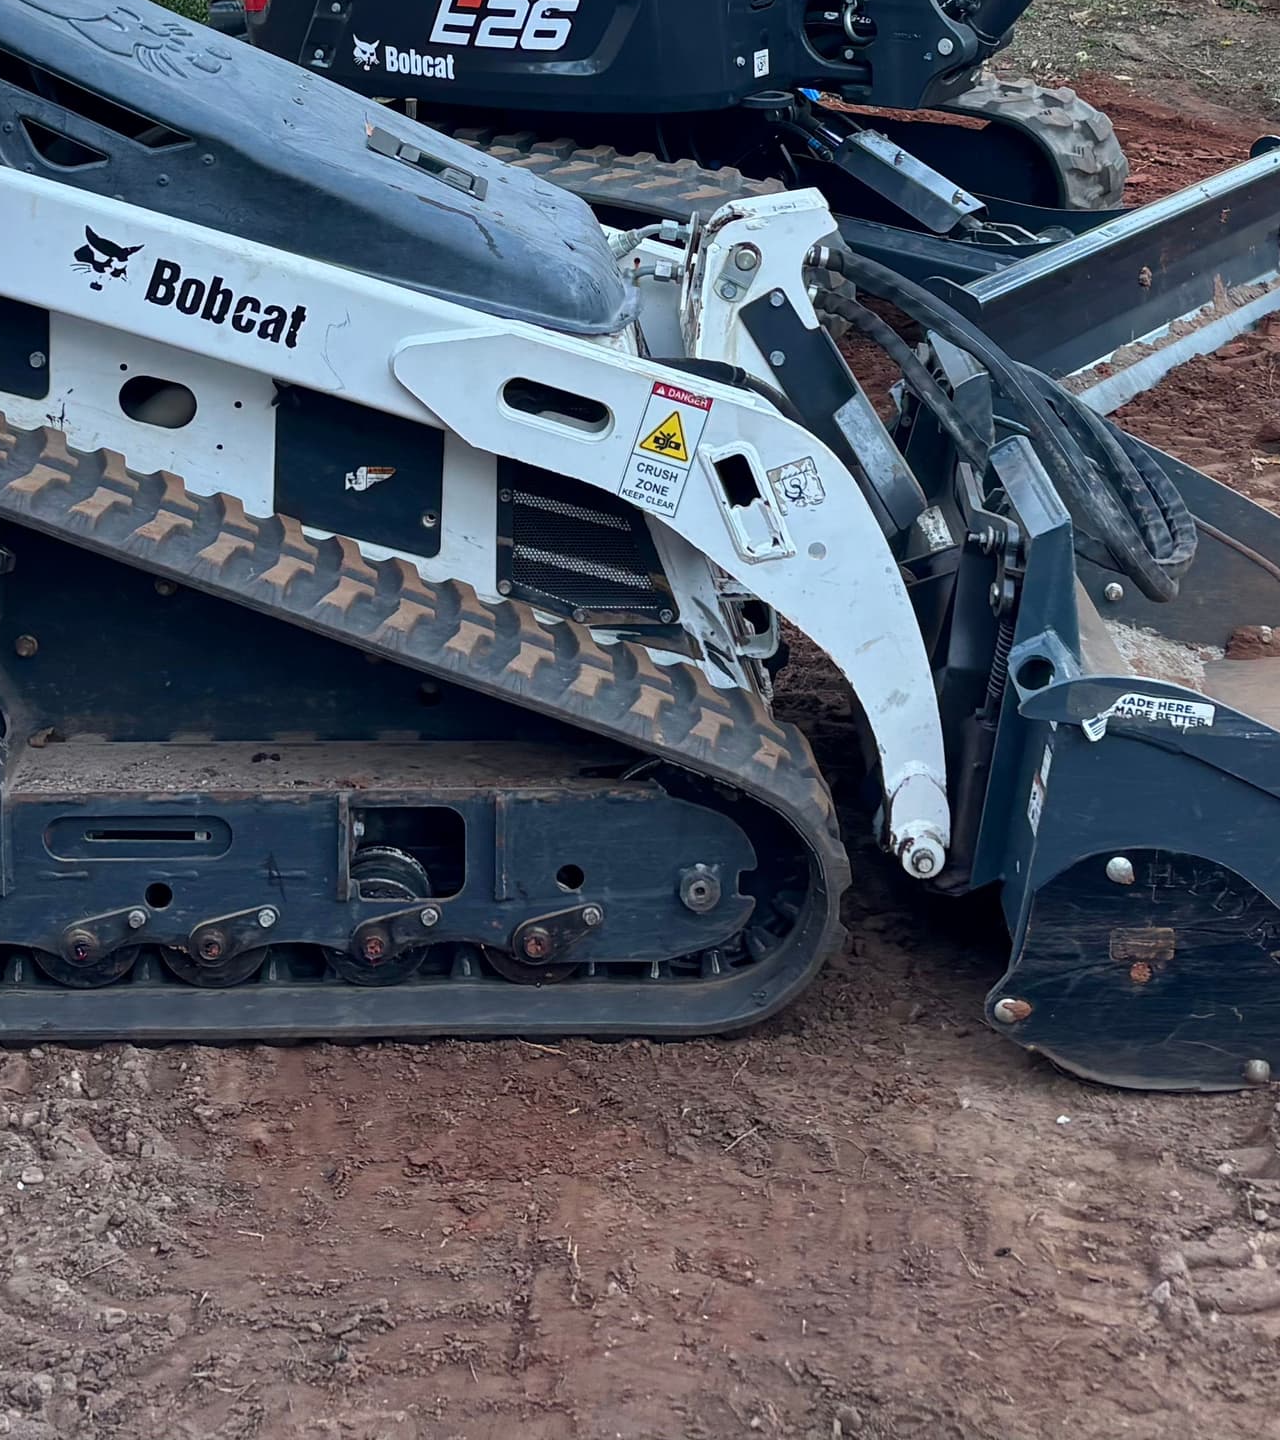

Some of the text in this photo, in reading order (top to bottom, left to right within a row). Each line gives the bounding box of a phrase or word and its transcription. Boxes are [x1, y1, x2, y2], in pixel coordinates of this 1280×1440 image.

[385, 46, 455, 79] Bobcat
[144, 258, 307, 348] Bobcat
[668, 389, 708, 408] DANGER
[636, 462, 679, 483] CRUSH
[635, 478, 670, 497] ZONE
[621, 488, 675, 511] KEEP CLEAR
[1158, 701, 1196, 714] HERE.
